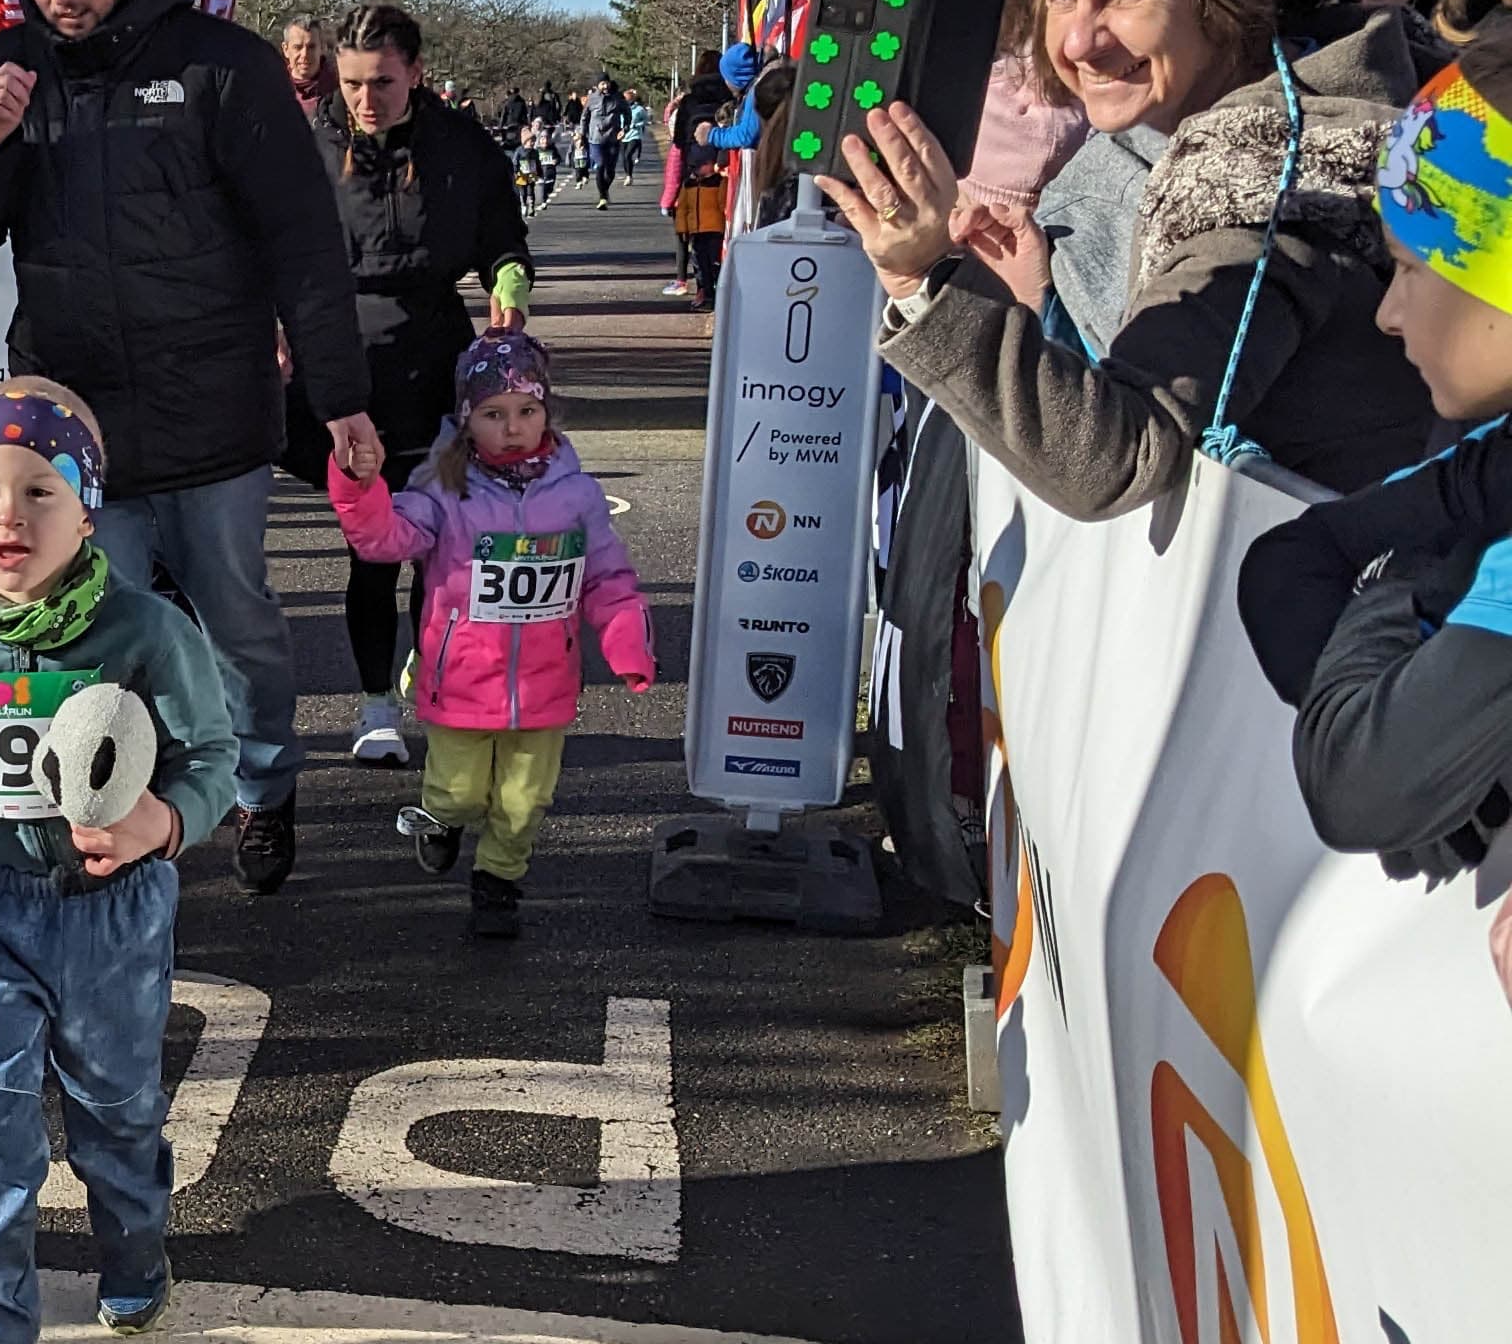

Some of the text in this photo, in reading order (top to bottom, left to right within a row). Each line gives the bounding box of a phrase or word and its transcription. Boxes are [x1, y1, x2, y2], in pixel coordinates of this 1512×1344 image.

[134, 87, 168, 97] NORTH
[150, 80, 169, 88] THE
[143, 96, 168, 104] FACE
[741, 375, 846, 408] innogy
[770, 429, 842, 446] Powered
[768, 446, 839, 465] by MVM
[792, 514, 822, 529] NN
[762, 564, 819, 584] ŠKODA
[477, 562, 576, 605] 3071
[751, 619, 810, 634] RUNTO
[731, 720, 801, 736] NUTREND
